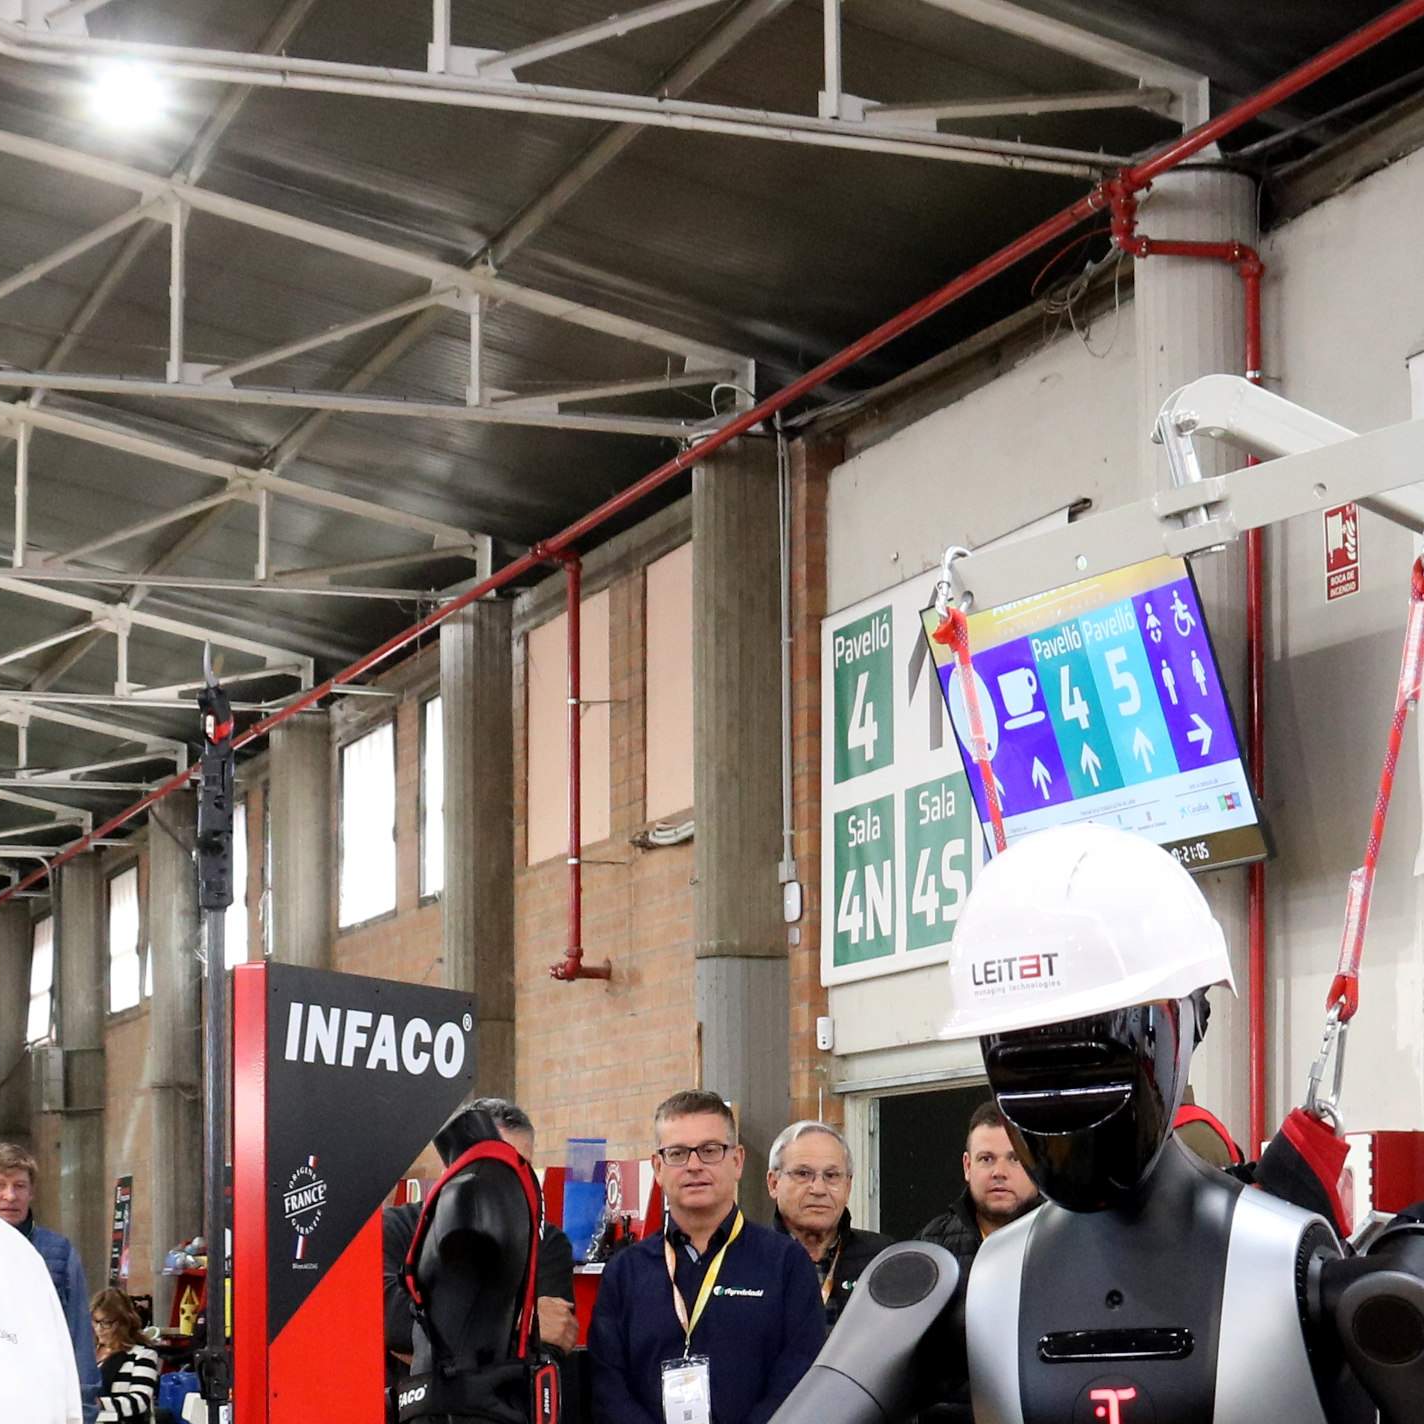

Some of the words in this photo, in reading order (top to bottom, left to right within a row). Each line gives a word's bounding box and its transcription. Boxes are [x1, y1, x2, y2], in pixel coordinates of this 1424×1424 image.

[834, 613, 891, 670] Pavelló
[1031, 624, 1082, 662] Pavelló
[1082, 609, 1136, 645] Pavelló
[1059, 664, 1090, 730] 4
[1104, 646, 1143, 717] 5
[847, 670, 879, 763] 4
[847, 807, 882, 848] Sala
[918, 786, 956, 826] Sala
[837, 859, 892, 945] 4N
[911, 837, 967, 928] 4S
[284, 1183, 324, 1214] FRANCE
